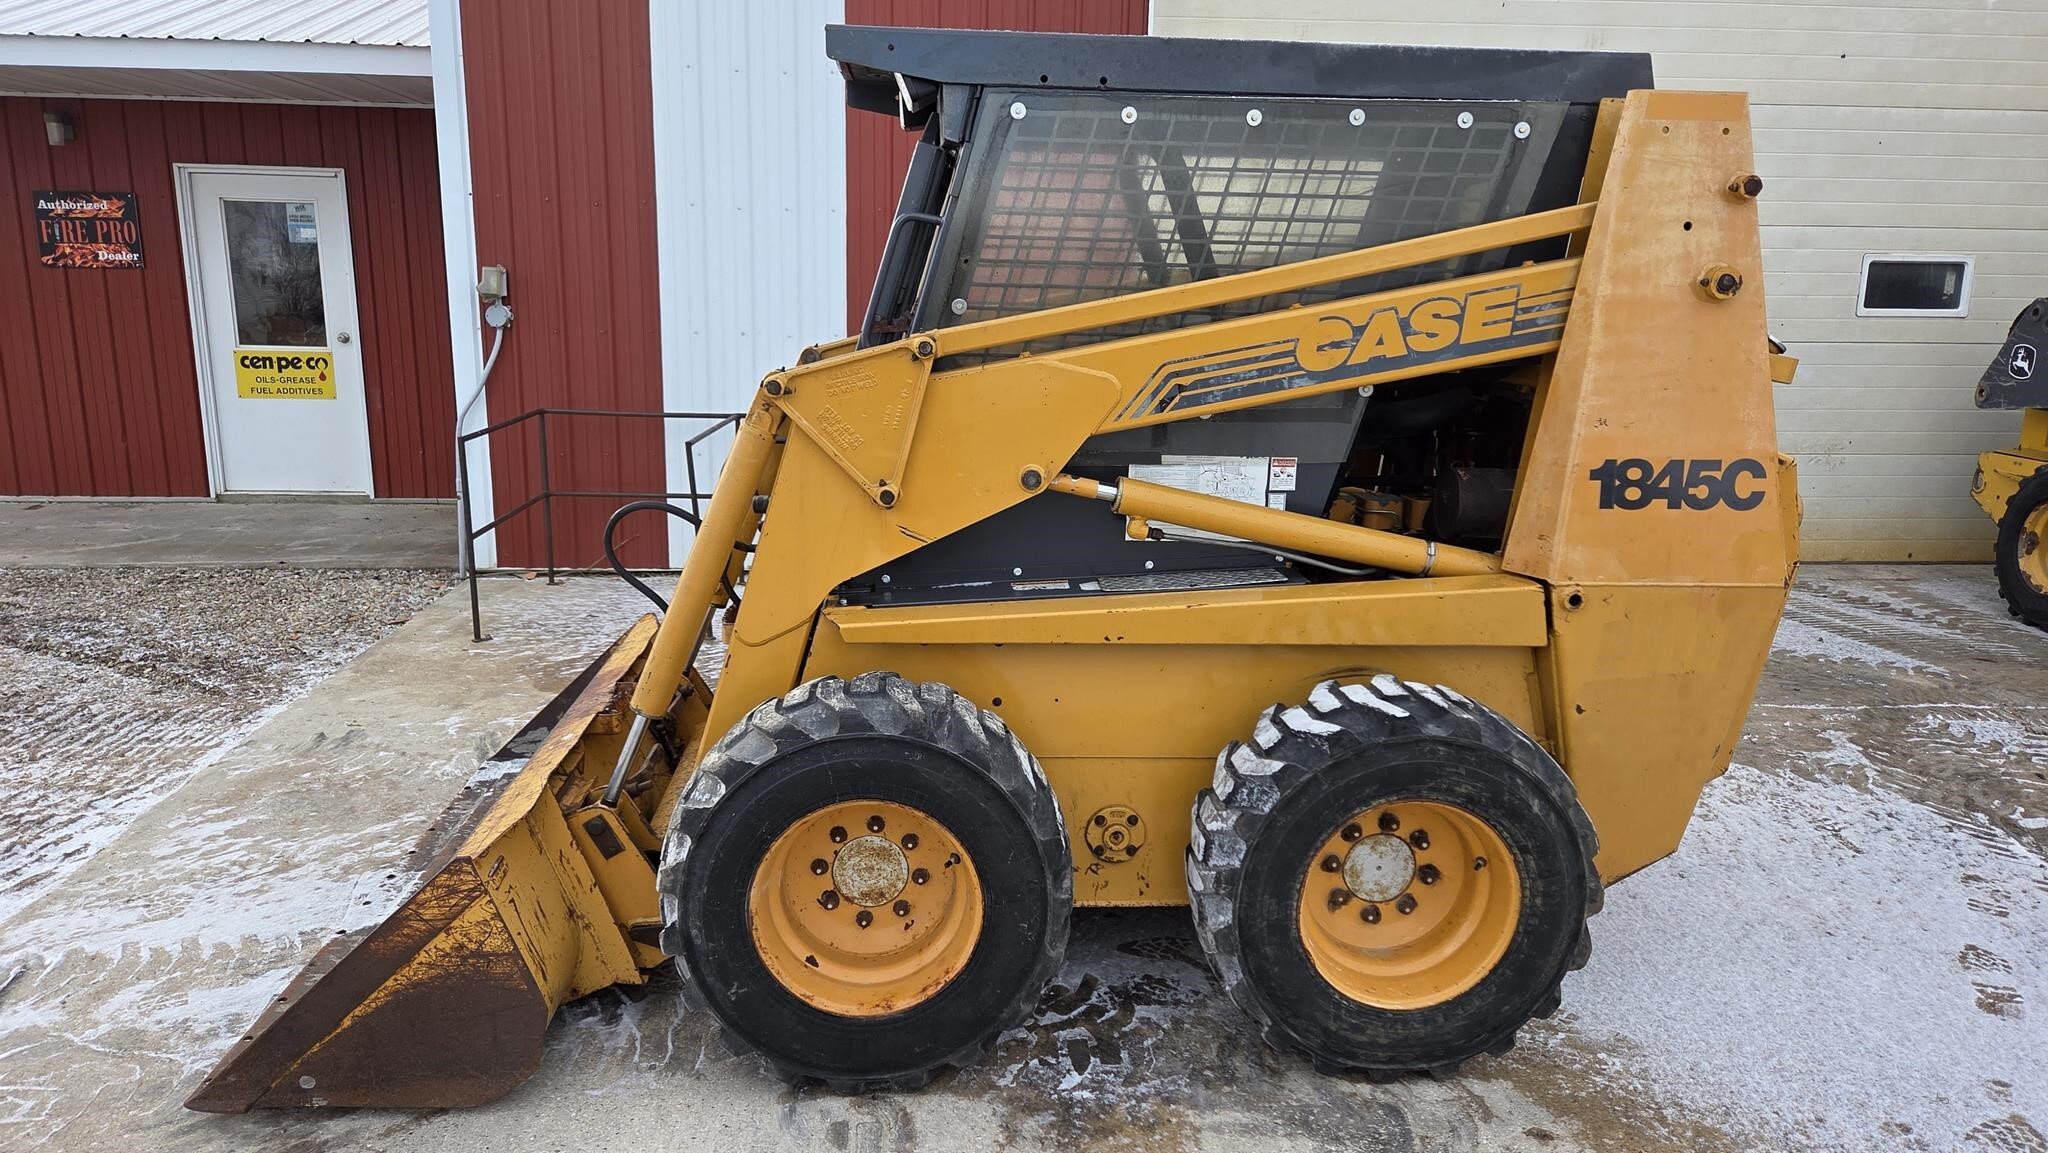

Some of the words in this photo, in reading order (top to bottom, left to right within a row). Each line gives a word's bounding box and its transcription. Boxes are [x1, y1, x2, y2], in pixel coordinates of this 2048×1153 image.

[37, 199, 108, 210] Authorized
[40, 219, 89, 243] FIRE
[95, 220, 137, 244] PRO
[97, 250, 139, 261] Dealer
[1296, 284, 1521, 371] CASE
[275, 387, 324, 395] ADDITIVES
[1589, 458, 1767, 511] 1845C
